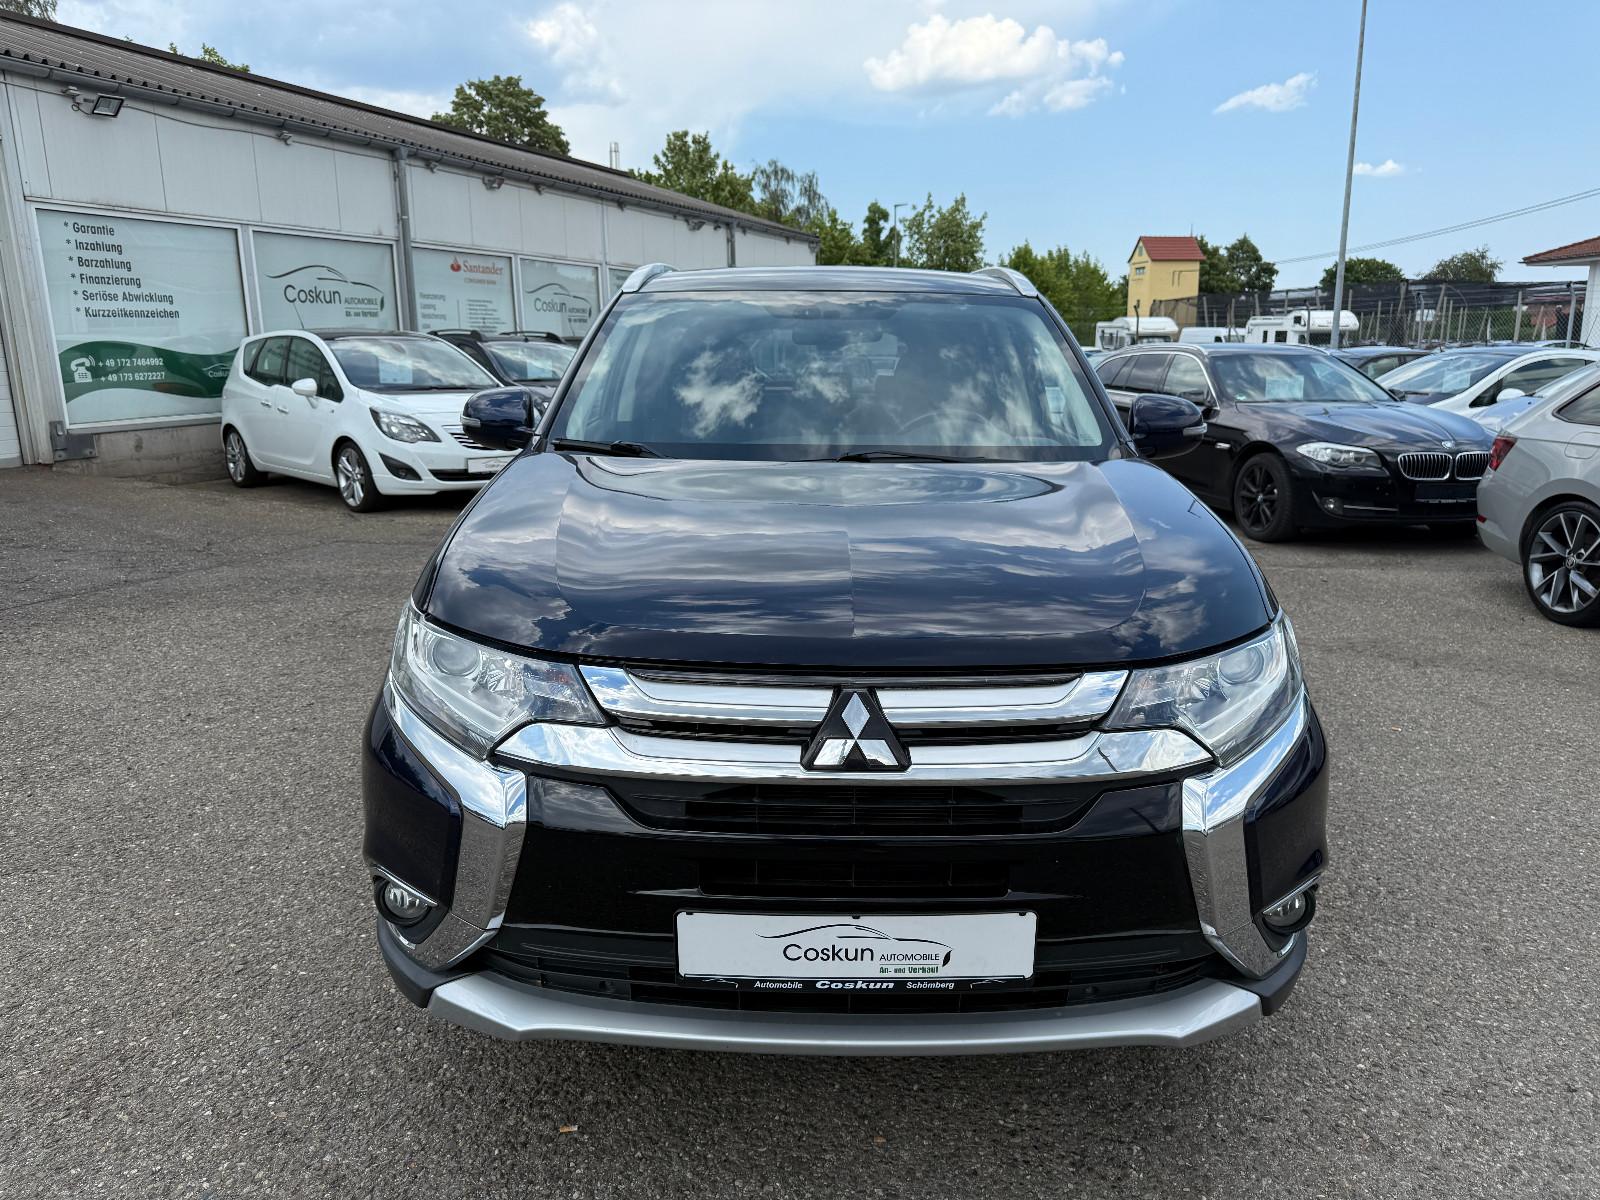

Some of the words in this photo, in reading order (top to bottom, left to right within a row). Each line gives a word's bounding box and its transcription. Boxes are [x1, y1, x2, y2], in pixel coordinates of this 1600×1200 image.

[72, 222, 115, 236] Garantie
[75, 239, 123, 255] Inzahlung
[77, 256, 132, 272] Barzahlung
[79, 273, 141, 288] Finanzierung
[82, 290, 119, 302] Seriöse
[122, 292, 174, 305] Abwicklung
[284, 284, 342, 304] Coskun
[84, 306, 180, 319] Kurzzeitkennzeichen
[534, 298, 567, 313] Coskun
[117, 358, 131, 367] 172
[119, 373, 133, 381] 173
[782, 943, 874, 962] Coskun
[879, 953, 940, 961] AUTOMOBILE
[754, 980, 803, 990] Automobile
[815, 980, 895, 990] Coskun
[906, 981, 955, 990] Schömberg
